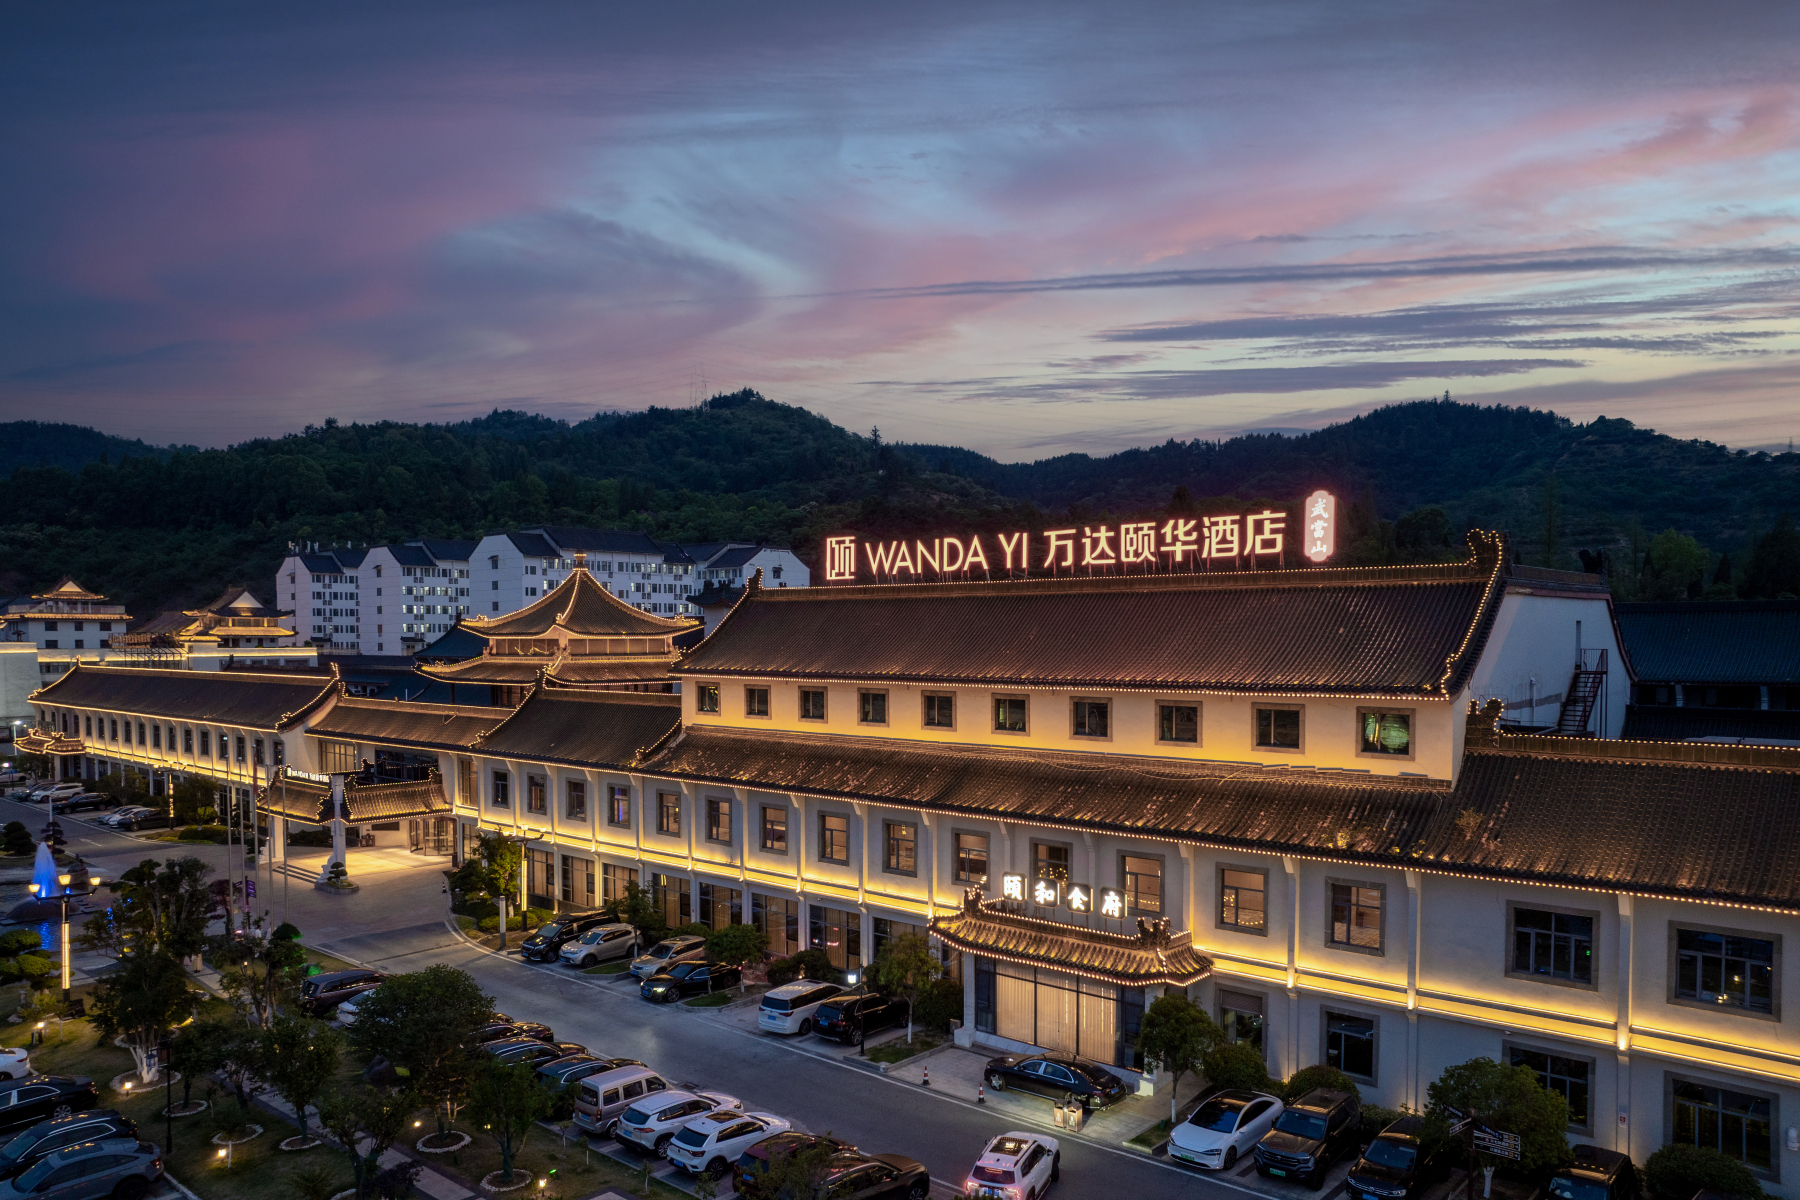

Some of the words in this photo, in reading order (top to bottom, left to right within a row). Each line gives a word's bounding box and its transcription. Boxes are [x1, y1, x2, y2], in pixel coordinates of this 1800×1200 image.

[865, 535, 988, 575] WANDA
[998, 532, 1028, 569] YI
[1043, 510, 1287, 568] 万达颐华酒店
